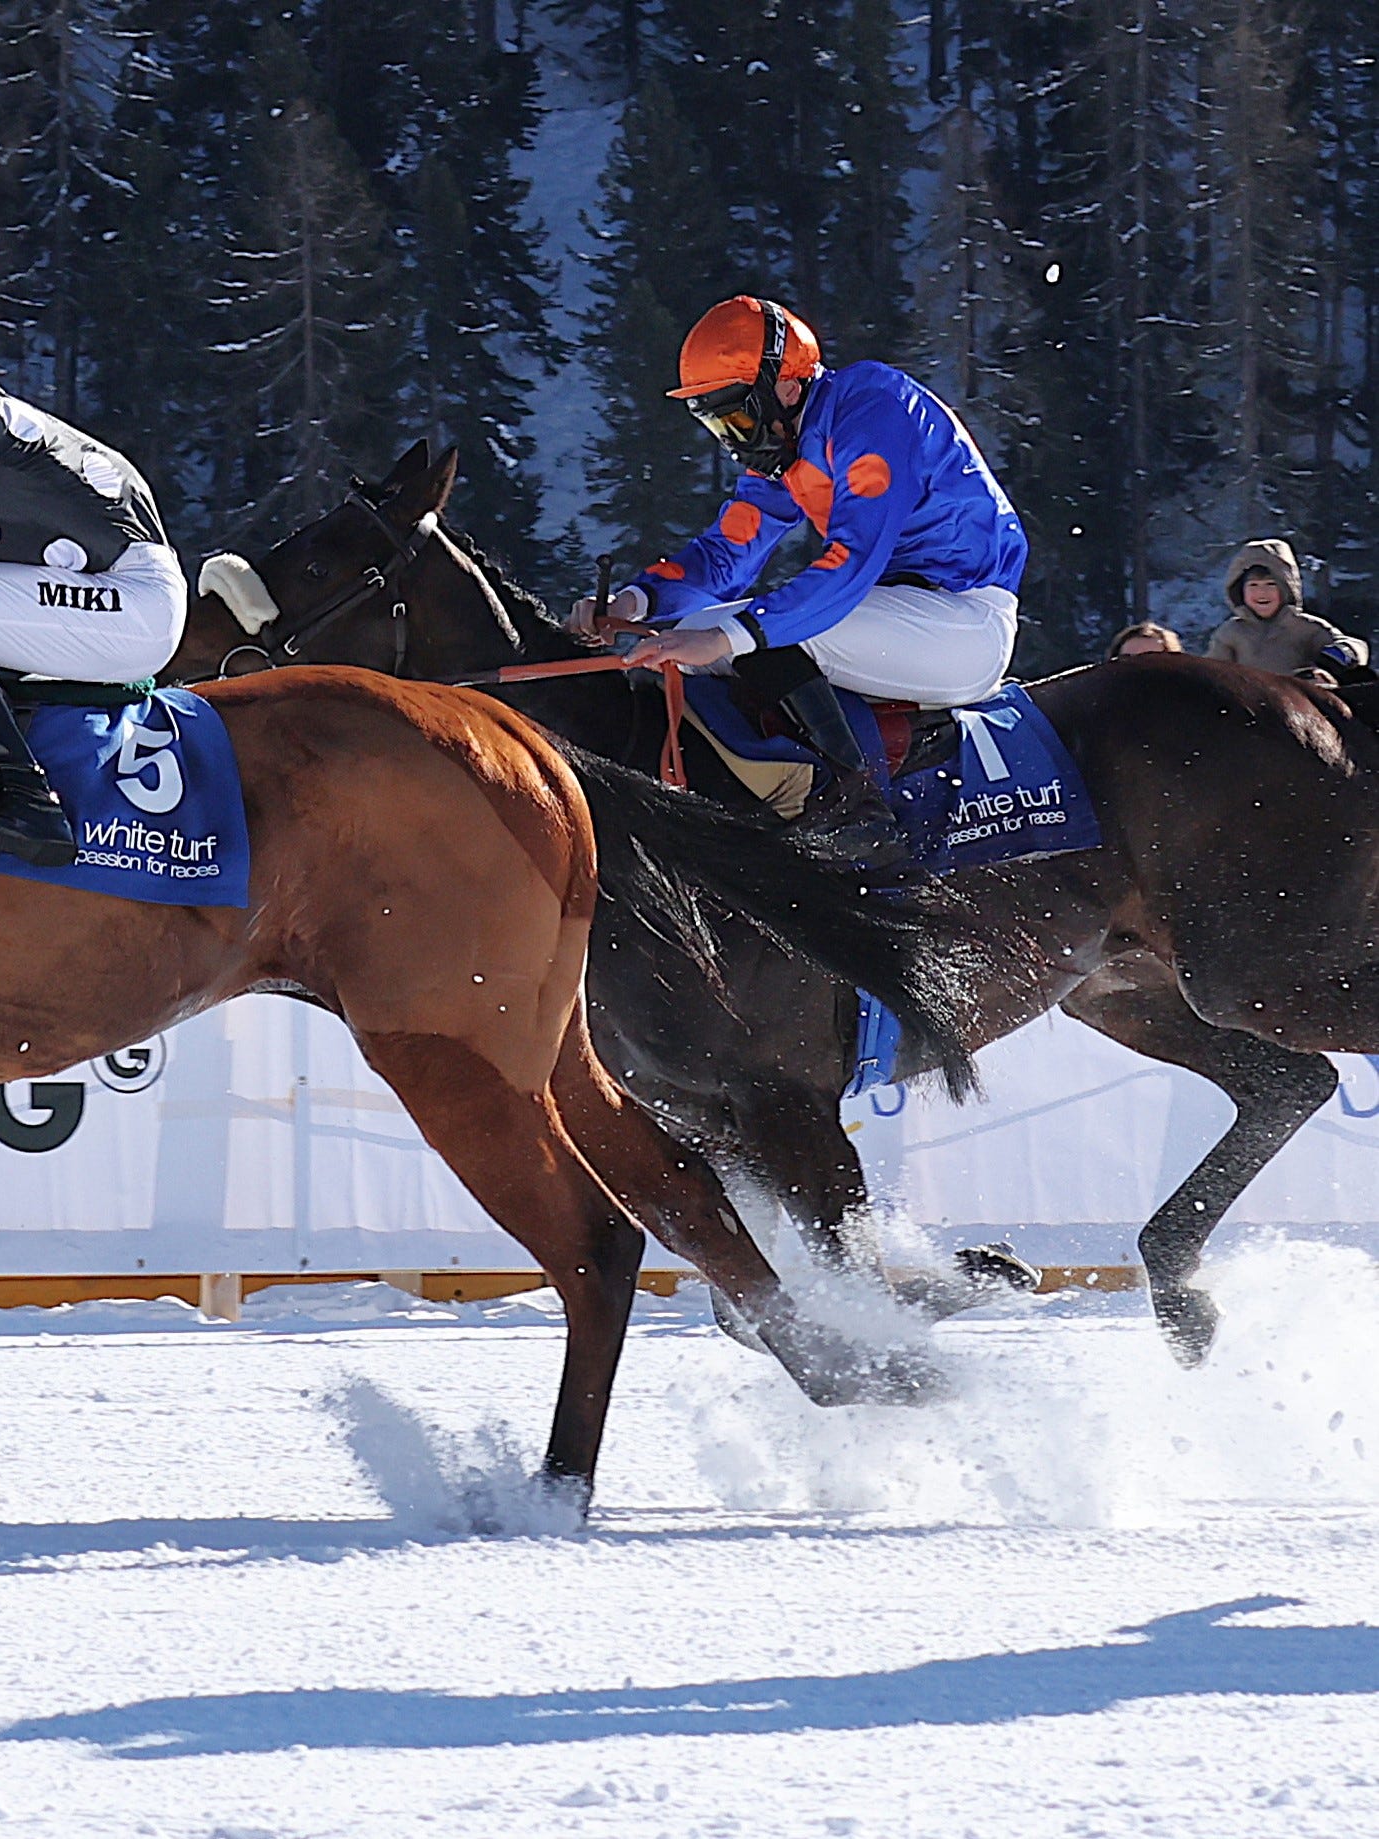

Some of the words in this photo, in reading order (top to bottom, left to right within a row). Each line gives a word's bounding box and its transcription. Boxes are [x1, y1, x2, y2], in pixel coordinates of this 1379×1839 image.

[115, 719, 183, 814] 5
[1015, 779, 1061, 808] turf
[84, 817, 165, 853] white
[170, 829, 217, 861] turf
[946, 823, 1000, 848] passion
[1003, 816, 1024, 832] for
[1028, 810, 1066, 825] races
[74, 850, 142, 870] passion
[146, 856, 168, 875] for
[170, 864, 220, 879] races
